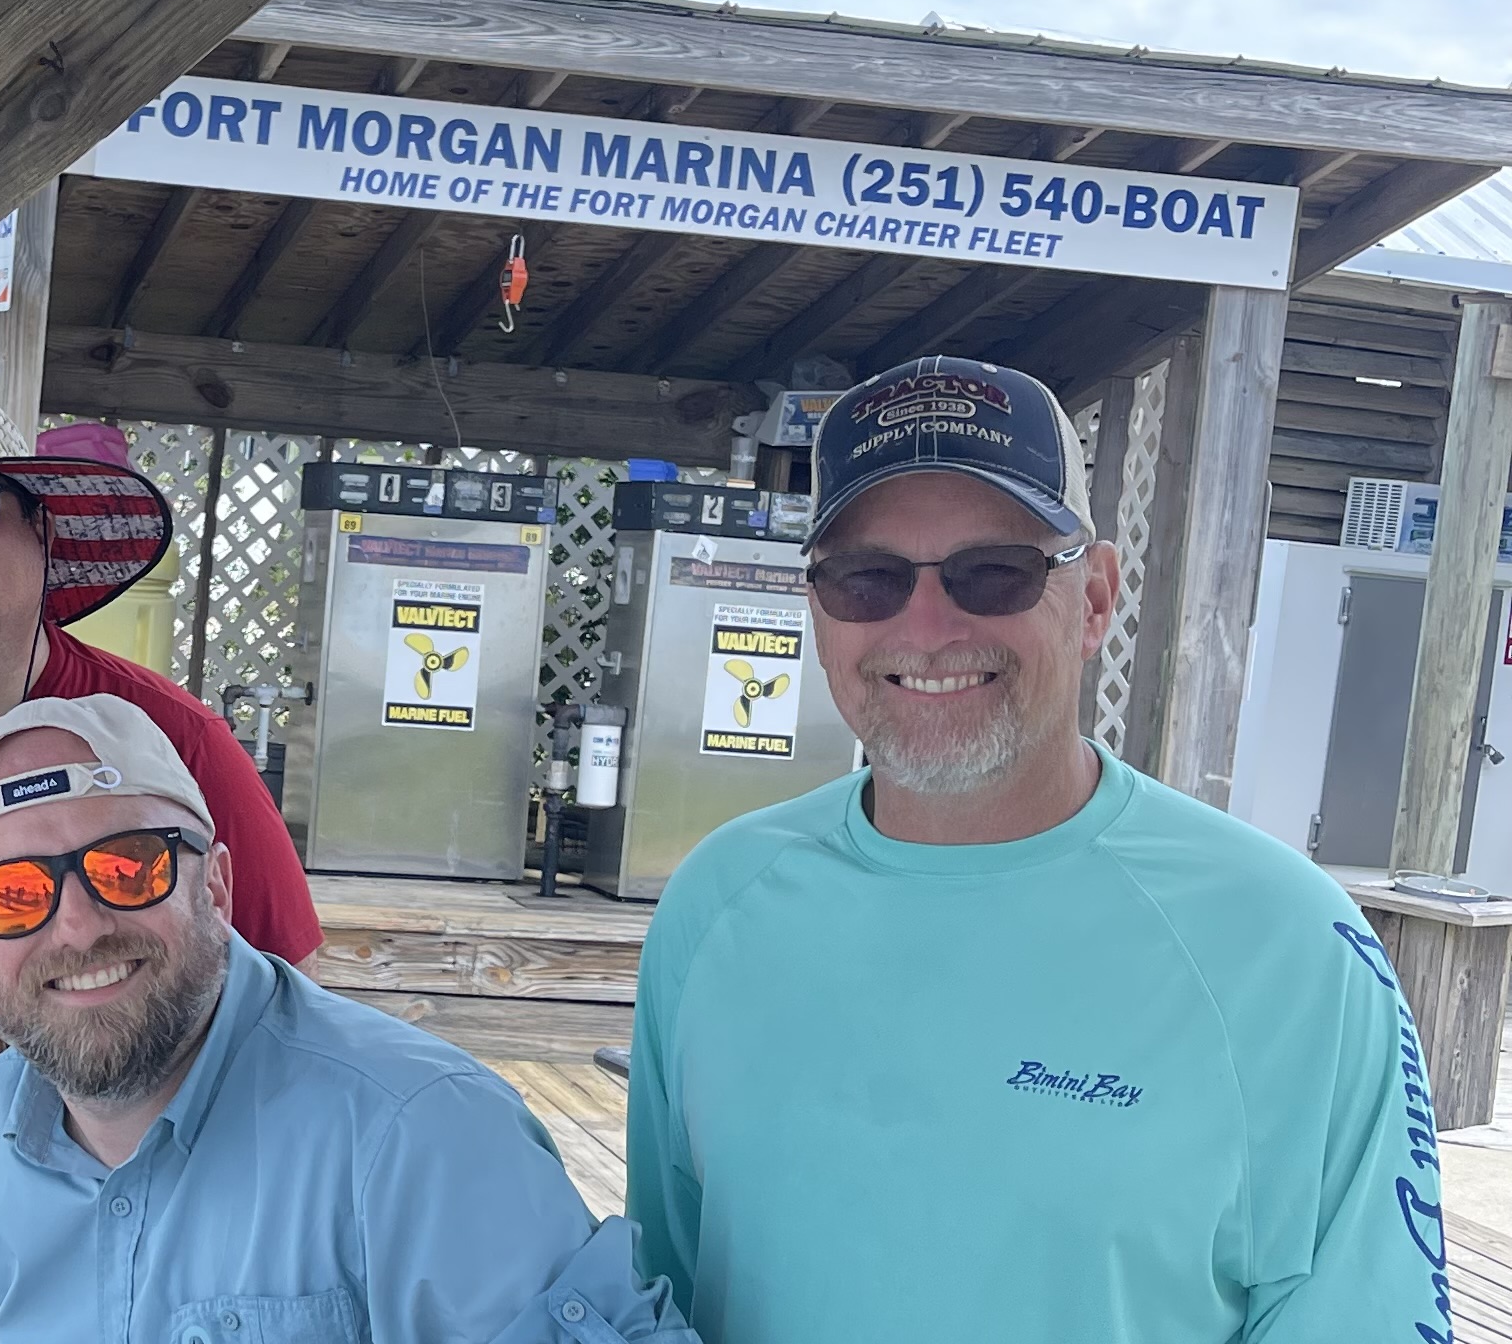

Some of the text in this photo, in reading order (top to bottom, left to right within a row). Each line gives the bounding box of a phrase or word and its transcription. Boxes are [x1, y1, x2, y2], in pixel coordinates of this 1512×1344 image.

[297, 104, 563, 174] MORGAN
[581, 131, 816, 197] MARINA
[842, 152, 985, 218] (251)
[999, 172, 1266, 239] 540-BOAT
[340, 166, 1063, 259] HOME OF THE FORT MORGAN CHARTER FLEET
[850, 373, 1012, 424] TRACTOR
[886, 401, 968, 419] Since 1938
[852, 421, 1014, 459] SUPPLY COMPANY
[494, 485, 506, 508] 3
[343, 519, 357, 530] 89
[525, 533, 538, 543] 89
[396, 605, 477, 629] VALVTECT
[717, 631, 798, 655] VALVTECT
[389, 706, 470, 724] MARINE FUEL
[707, 734, 789, 753] MARINE FUEL
[13, 778, 50, 798] ahead
[1006, 1060, 1143, 1107] Bimini Bay
